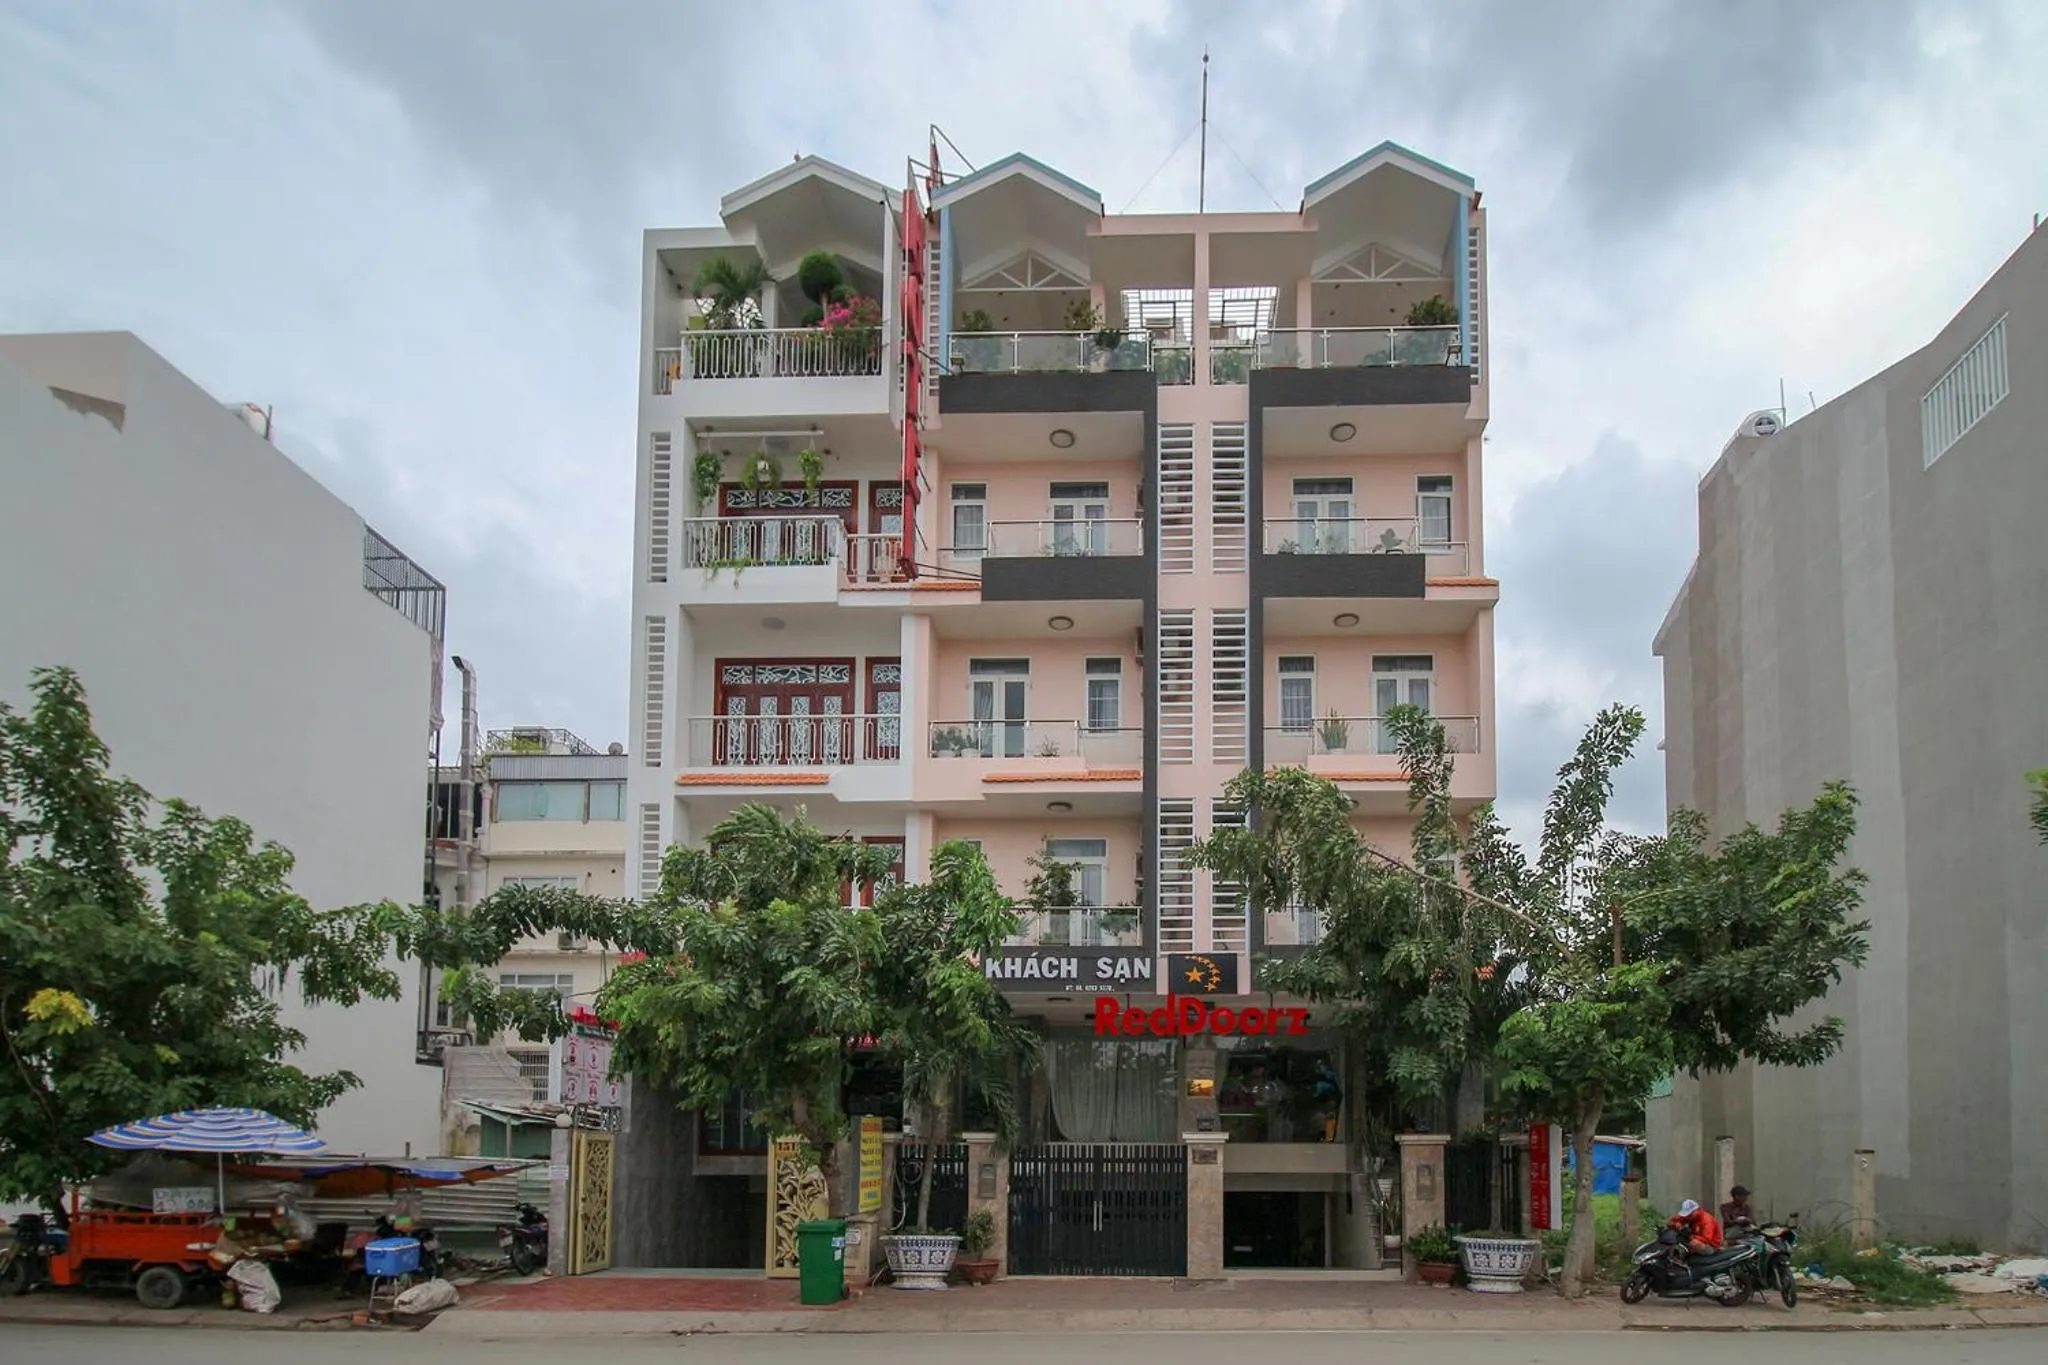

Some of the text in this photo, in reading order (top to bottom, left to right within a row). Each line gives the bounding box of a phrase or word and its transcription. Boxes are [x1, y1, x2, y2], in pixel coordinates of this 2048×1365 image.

[985, 952, 1151, 984] KHÁCH SẠN
[1094, 993, 1309, 1036] RedDoorz
